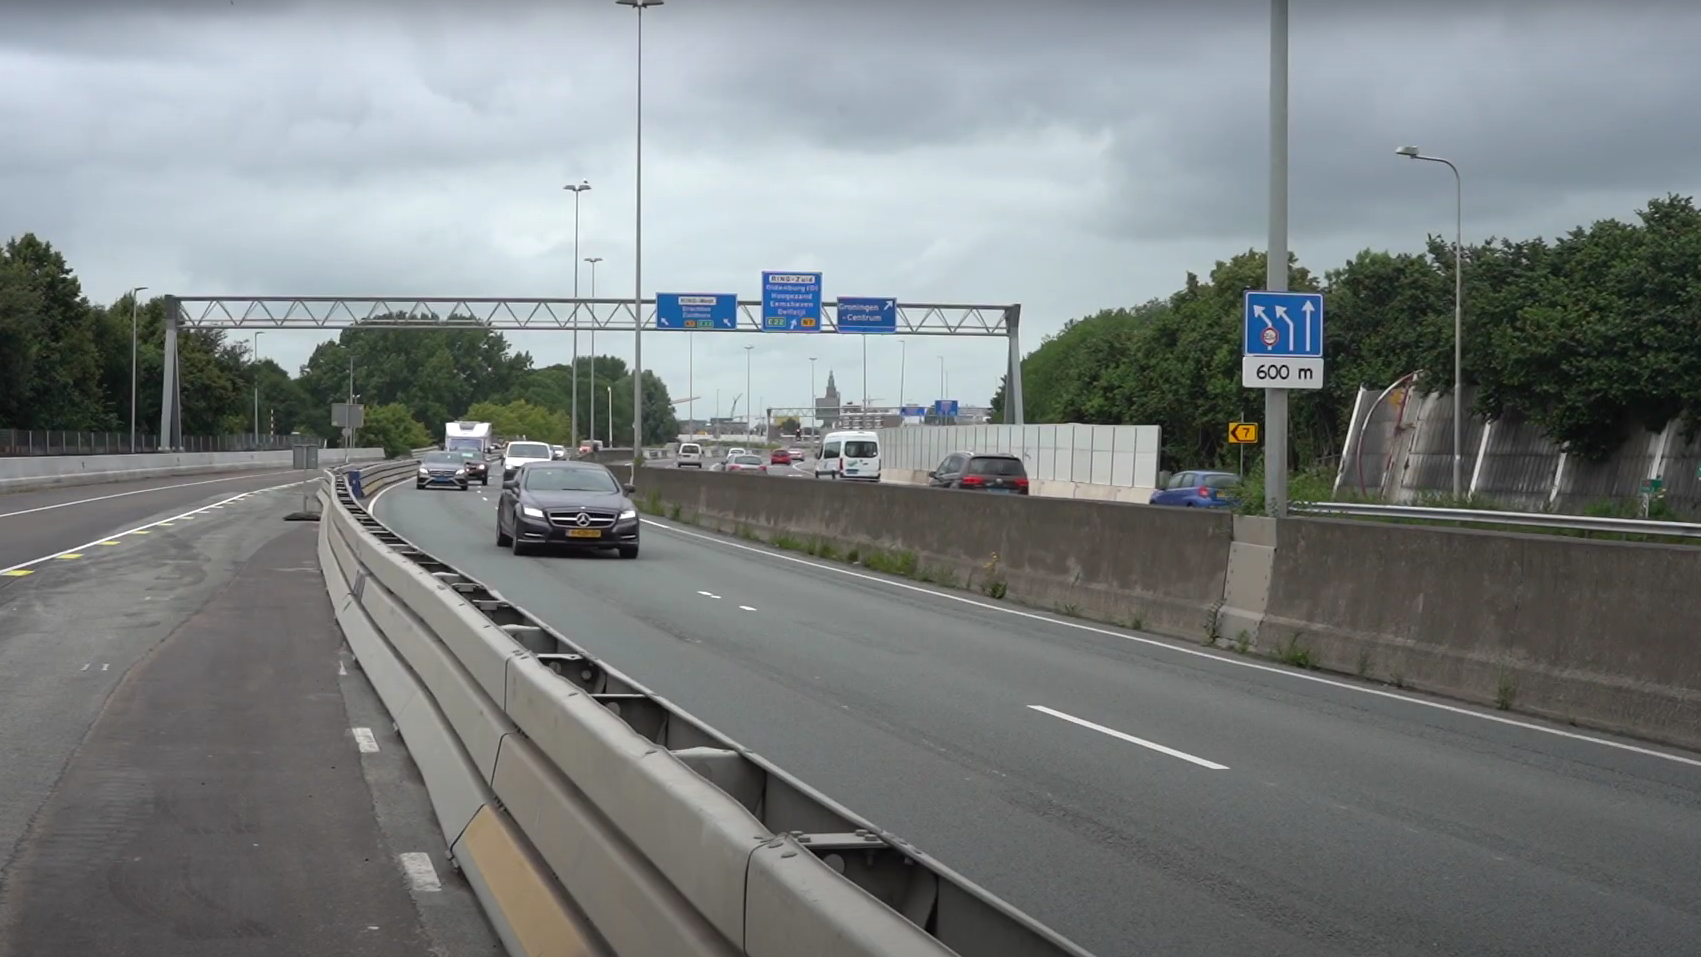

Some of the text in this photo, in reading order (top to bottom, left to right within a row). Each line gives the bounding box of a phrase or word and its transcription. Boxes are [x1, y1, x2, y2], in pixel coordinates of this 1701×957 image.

[838, 303, 879, 313] Groningen
[1256, 364, 1313, 380] 600 m
[1242, 427, 1250, 438] 7
